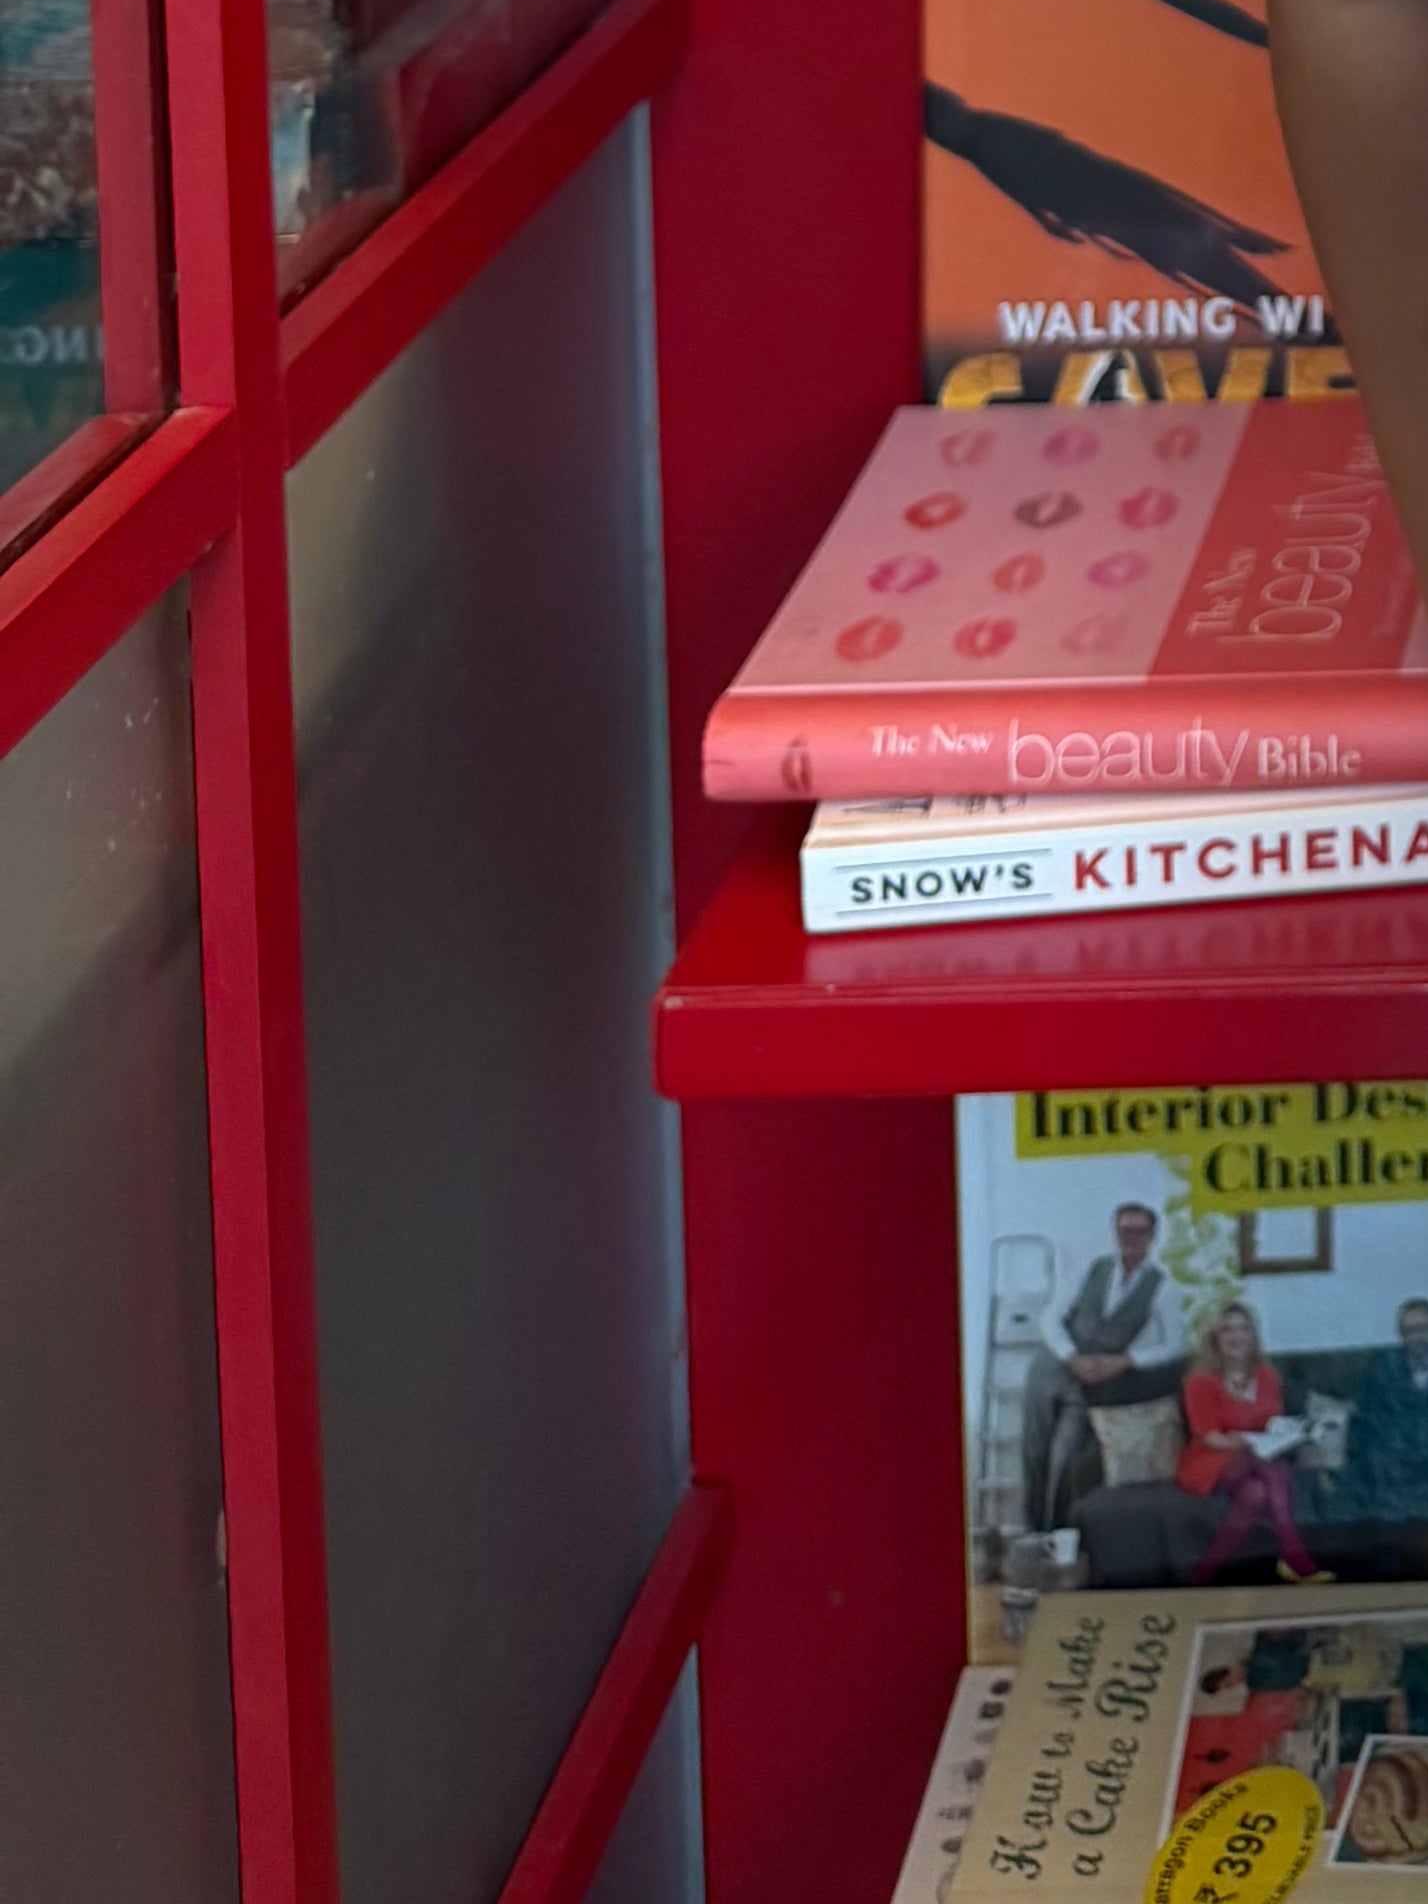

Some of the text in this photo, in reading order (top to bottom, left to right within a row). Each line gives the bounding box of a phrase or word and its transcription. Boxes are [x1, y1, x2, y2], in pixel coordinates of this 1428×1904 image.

[999, 297, 1237, 345] WALKING
[1214, 470, 1388, 643] beauty
[869, 715, 1362, 786] The New beauty Bible
[850, 861, 1034, 905] SNOW'S
[1032, 1089, 1290, 1141] Interior
[989, 1616, 1105, 1881] How to Make
[1064, 1613, 1177, 1876] a Cake Rise
[1183, 1781, 1249, 1833] Books
[1212, 1811, 1278, 1880] 395
